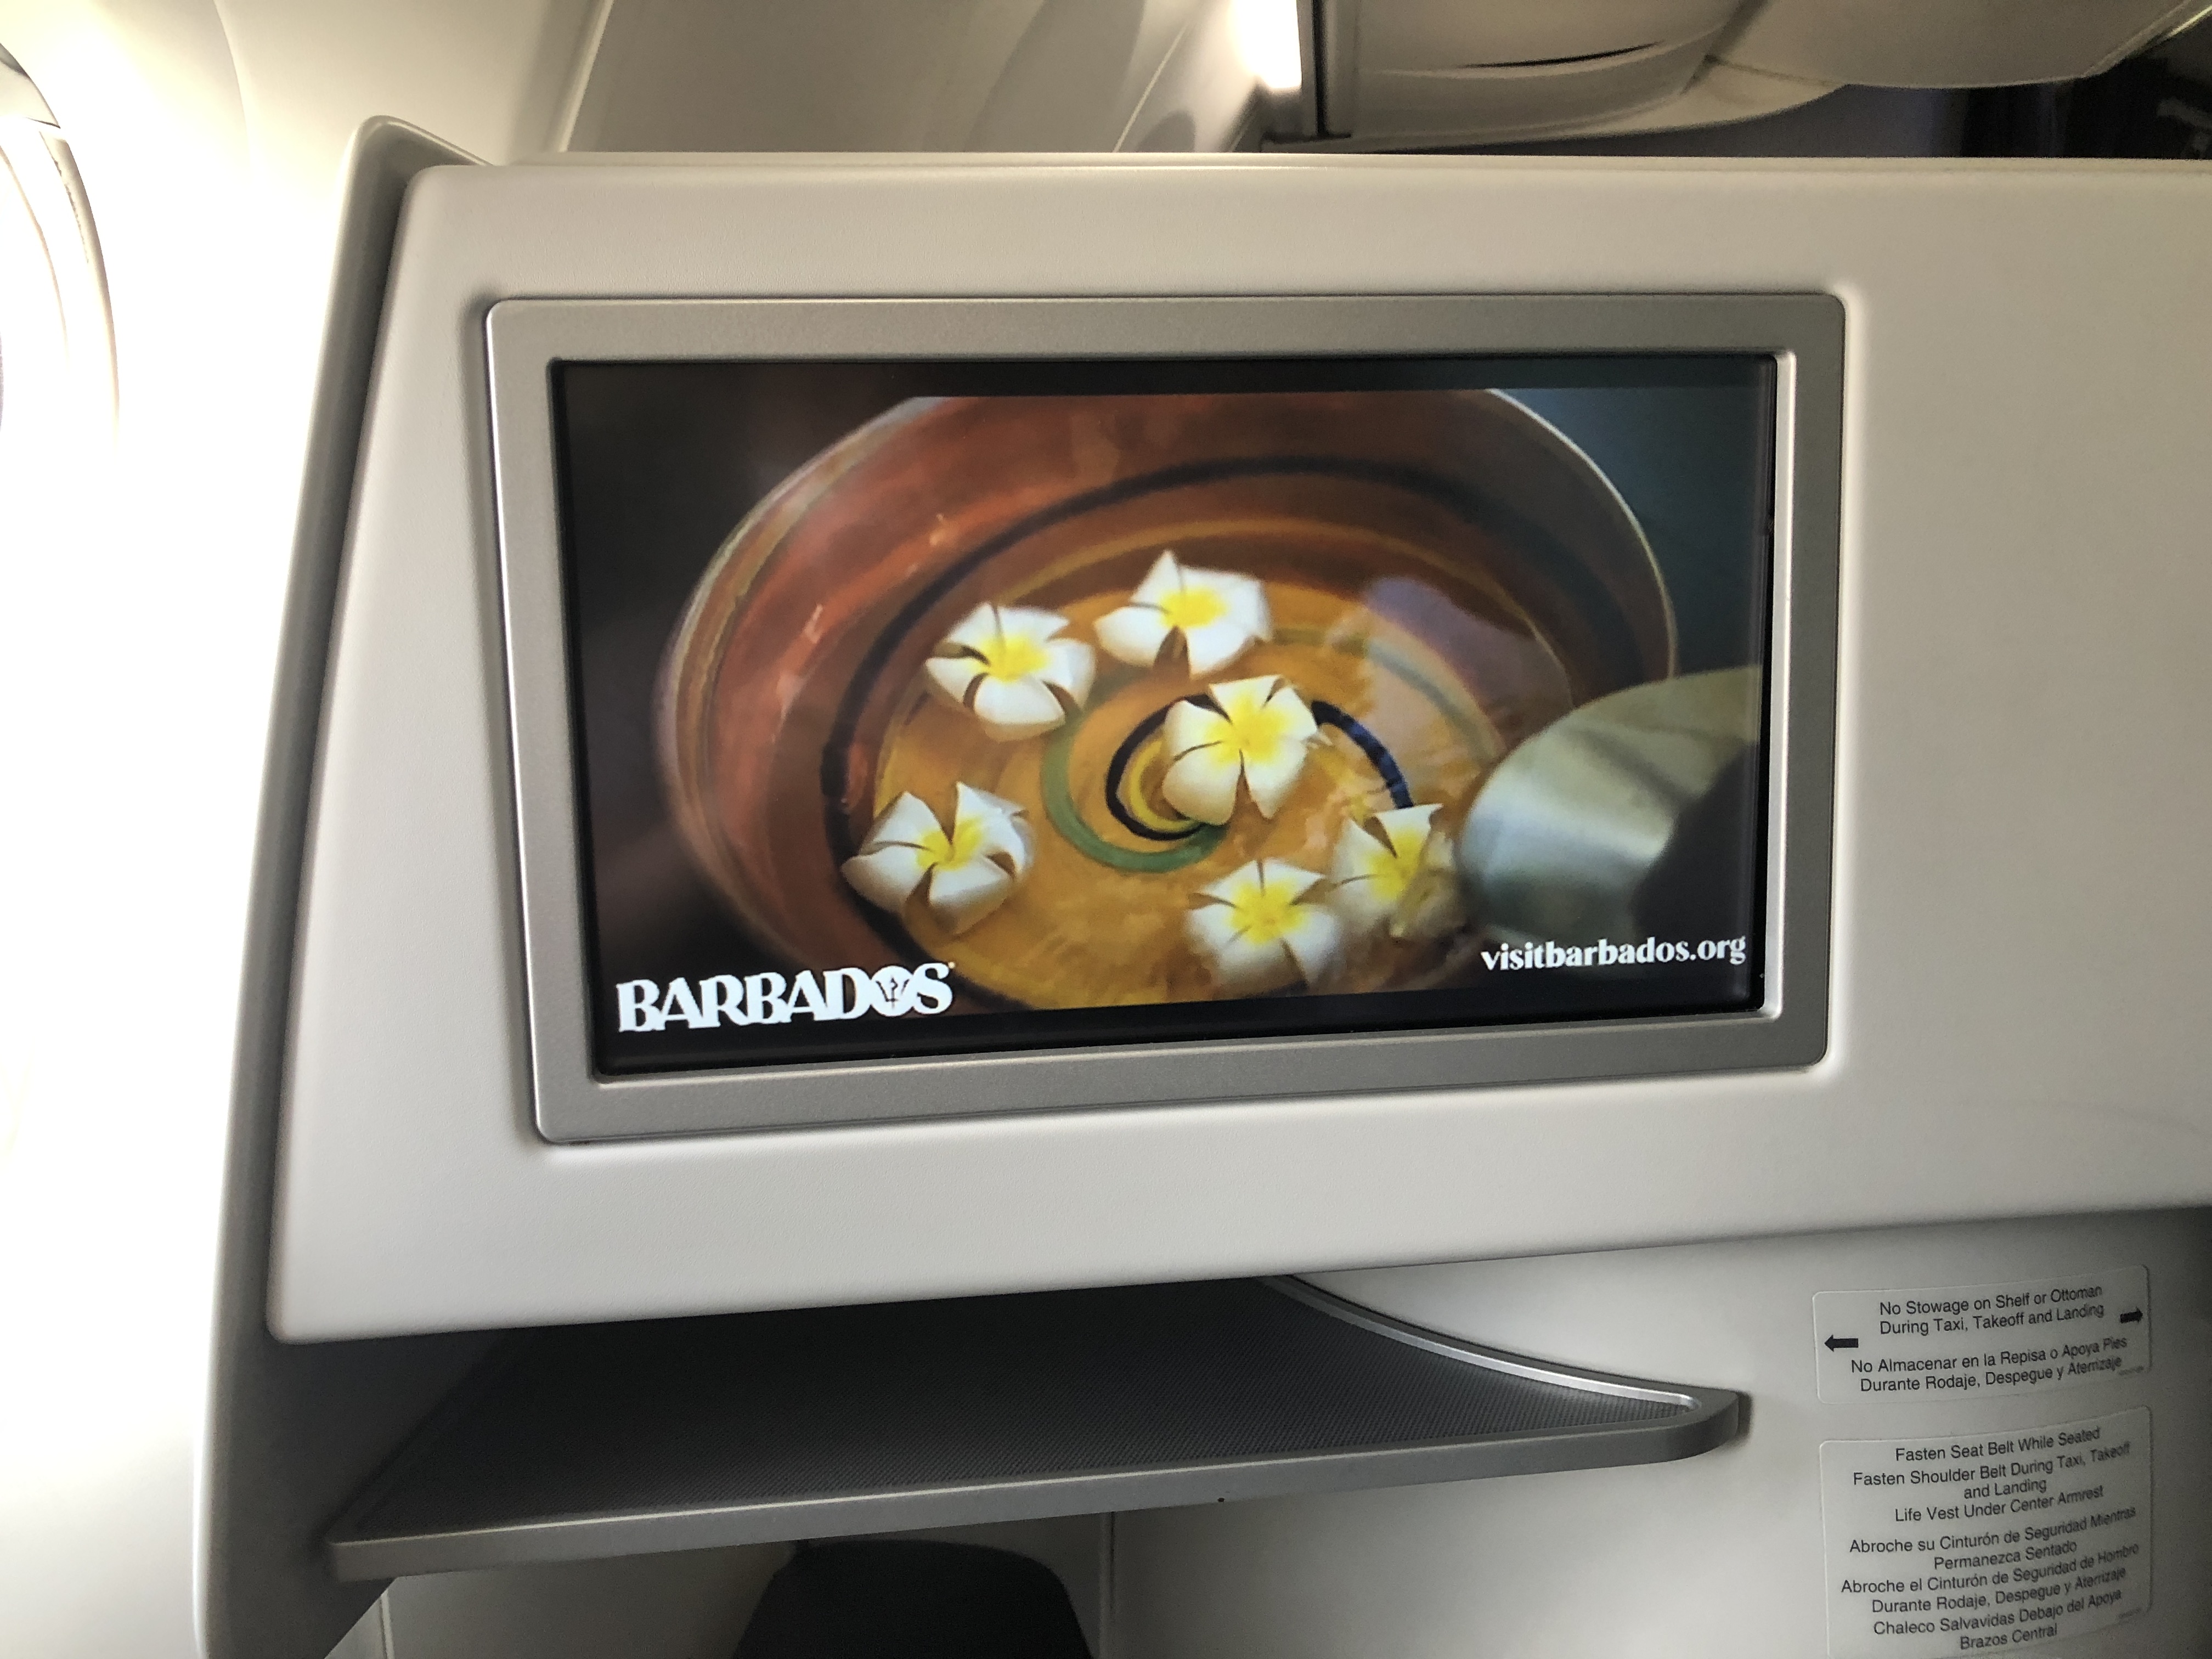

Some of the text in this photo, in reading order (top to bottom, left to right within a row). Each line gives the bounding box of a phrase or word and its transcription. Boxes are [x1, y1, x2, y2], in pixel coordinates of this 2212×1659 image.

[1481, 936, 1746, 970] visitbarbados.org
[616, 963, 952, 1032] BARBADOS
[1880, 1286, 2102, 1315] No Stowage on Shelf or Ottoman
[1880, 1304, 2104, 1336] During Taxi, Takeoff and Landing
[1852, 1337, 2127, 1373] No Almacenar en la Repisa o Apoya Pies
[1861, 1378, 1920, 1391] Durante
[1926, 1374, 1980, 1390] Rodaje,
[1985, 1368, 2053, 1386] Despegue
[2057, 1367, 2064, 1380] y
[1895, 1426, 2101, 1461] Fasten Seat Belt While Seated
[1854, 1441, 2130, 1486] Fasten Shoulder Belt During Taxi, Takeoff
[1895, 1485, 2103, 1521] Life Vest Under Center Armrest
[1964, 1479, 2047, 1499] and Landing
[1850, 1539, 1913, 1553] Abroche
[1918, 1541, 1934, 1551] su
[1940, 1532, 1999, 1549] Cinturón
[2004, 1530, 2021, 1543] de
[2025, 1516, 2087, 1541] Seguridad
[1841, 1544, 2139, 1593] Abroche el Cinturón de Seguridad de Hombro
[1934, 1541, 2077, 1570] Permanezca Sentado
[1872, 1599, 1931, 1612] Durante
[1937, 1594, 1990, 1610] Rodaje,
[1995, 1584, 2061, 1604] Despegue
[2064, 1582, 2072, 1595] y
[1874, 1590, 2122, 1634] Chaleco Salvavidas Debajo del Apoya
[1960, 1623, 2057, 1650] Brazos Central
